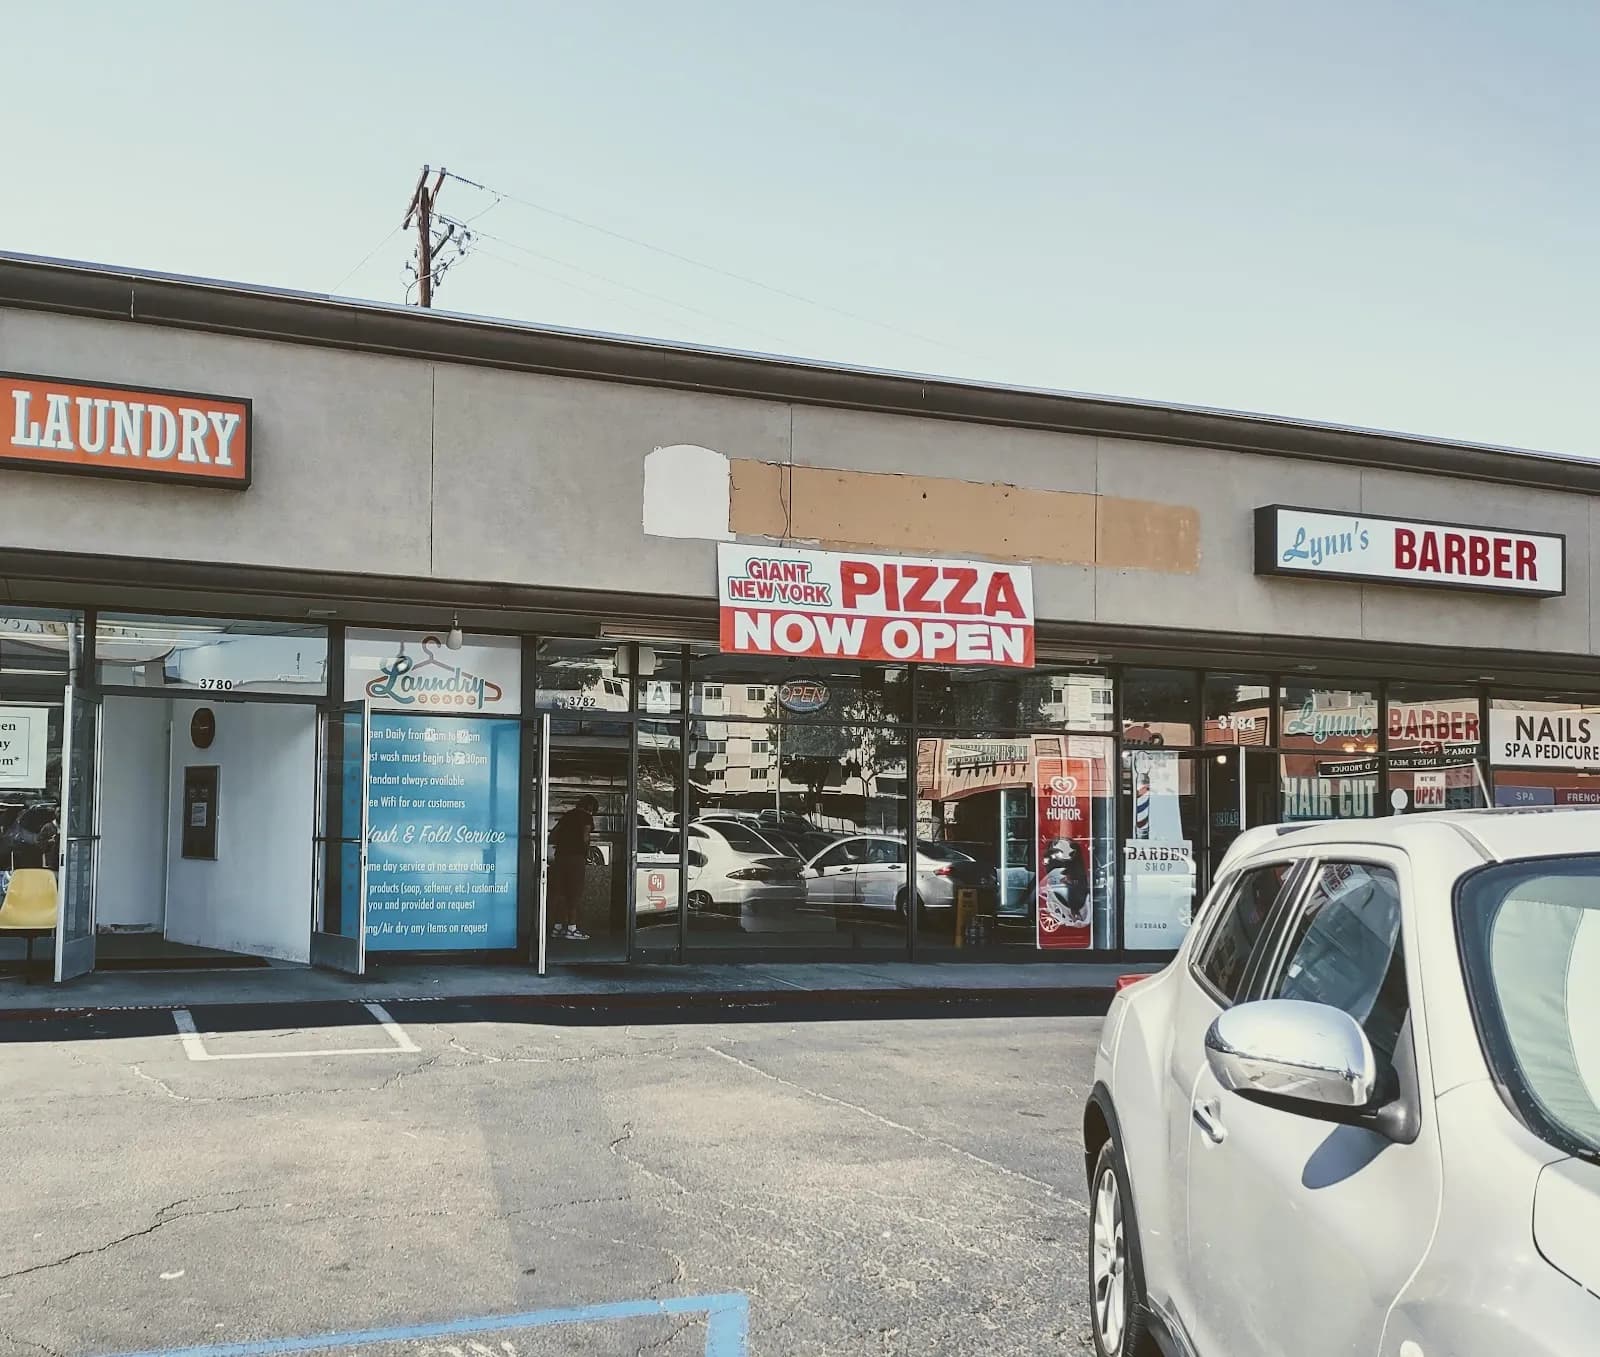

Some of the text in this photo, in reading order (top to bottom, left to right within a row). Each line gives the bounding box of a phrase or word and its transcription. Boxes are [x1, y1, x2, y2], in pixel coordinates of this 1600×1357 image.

[11, 390, 240, 466] LAUNDRY
[1282, 521, 1537, 581] Lynn's BARBER
[748, 559, 808, 583] GIANT
[730, 580, 830, 604] NEW YORK
[840, 560, 1026, 619] PIZZA
[734, 611, 1025, 663] NOW OPEN
[199, 678, 233, 691] 3780
[371, 655, 485, 709] Laundry
[569, 696, 596, 707] 3782
[780, 686, 827, 702] OPEN
[1218, 715, 1256, 730] 3784
[1287, 696, 1373, 744] Lynn's
[1388, 708, 1480, 741] BARBER
[386, 728, 406, 742] Daily
[1515, 715, 1591, 743] NAILS
[380, 750, 400, 761] wash
[402, 752, 420, 762] must
[423, 751, 443, 766] begin
[1505, 743, 1600, 760] SPA PEDICURE
[402, 773, 428, 787] always
[430, 775, 465, 786] available
[380, 796, 396, 807] Wifi
[399, 796, 411, 808] for
[412, 799, 425, 808] our
[428, 799, 466, 808] customers
[1051, 795, 1076, 807] GOOD
[1284, 776, 1376, 817] HAIR CUT
[1415, 786, 1443, 804] OPEN
[1515, 792, 1534, 801] SPA
[1567, 793, 1600, 802] FRENCH
[1047, 808, 1081, 820] HUMOR
[403, 825, 416, 843] &
[419, 824, 453, 843] Fold
[455, 825, 507, 843] Service
[1127, 847, 1189, 861] BARBER
[383, 860, 397, 873] day
[400, 861, 425, 871] service
[437, 862, 447, 871] no
[449, 861, 468, 871] extra
[470, 860, 495, 873] charge
[1145, 862, 1173, 871] SHOP
[370, 882, 399, 896] products
[471, 882, 509, 893] customized
[368, 898, 475, 912] you and provided on request
[396, 921, 409, 935] dry
[411, 925, 424, 936] any
[428, 922, 448, 933] items
[450, 924, 459, 933] on
[461, 922, 488, 936] request
